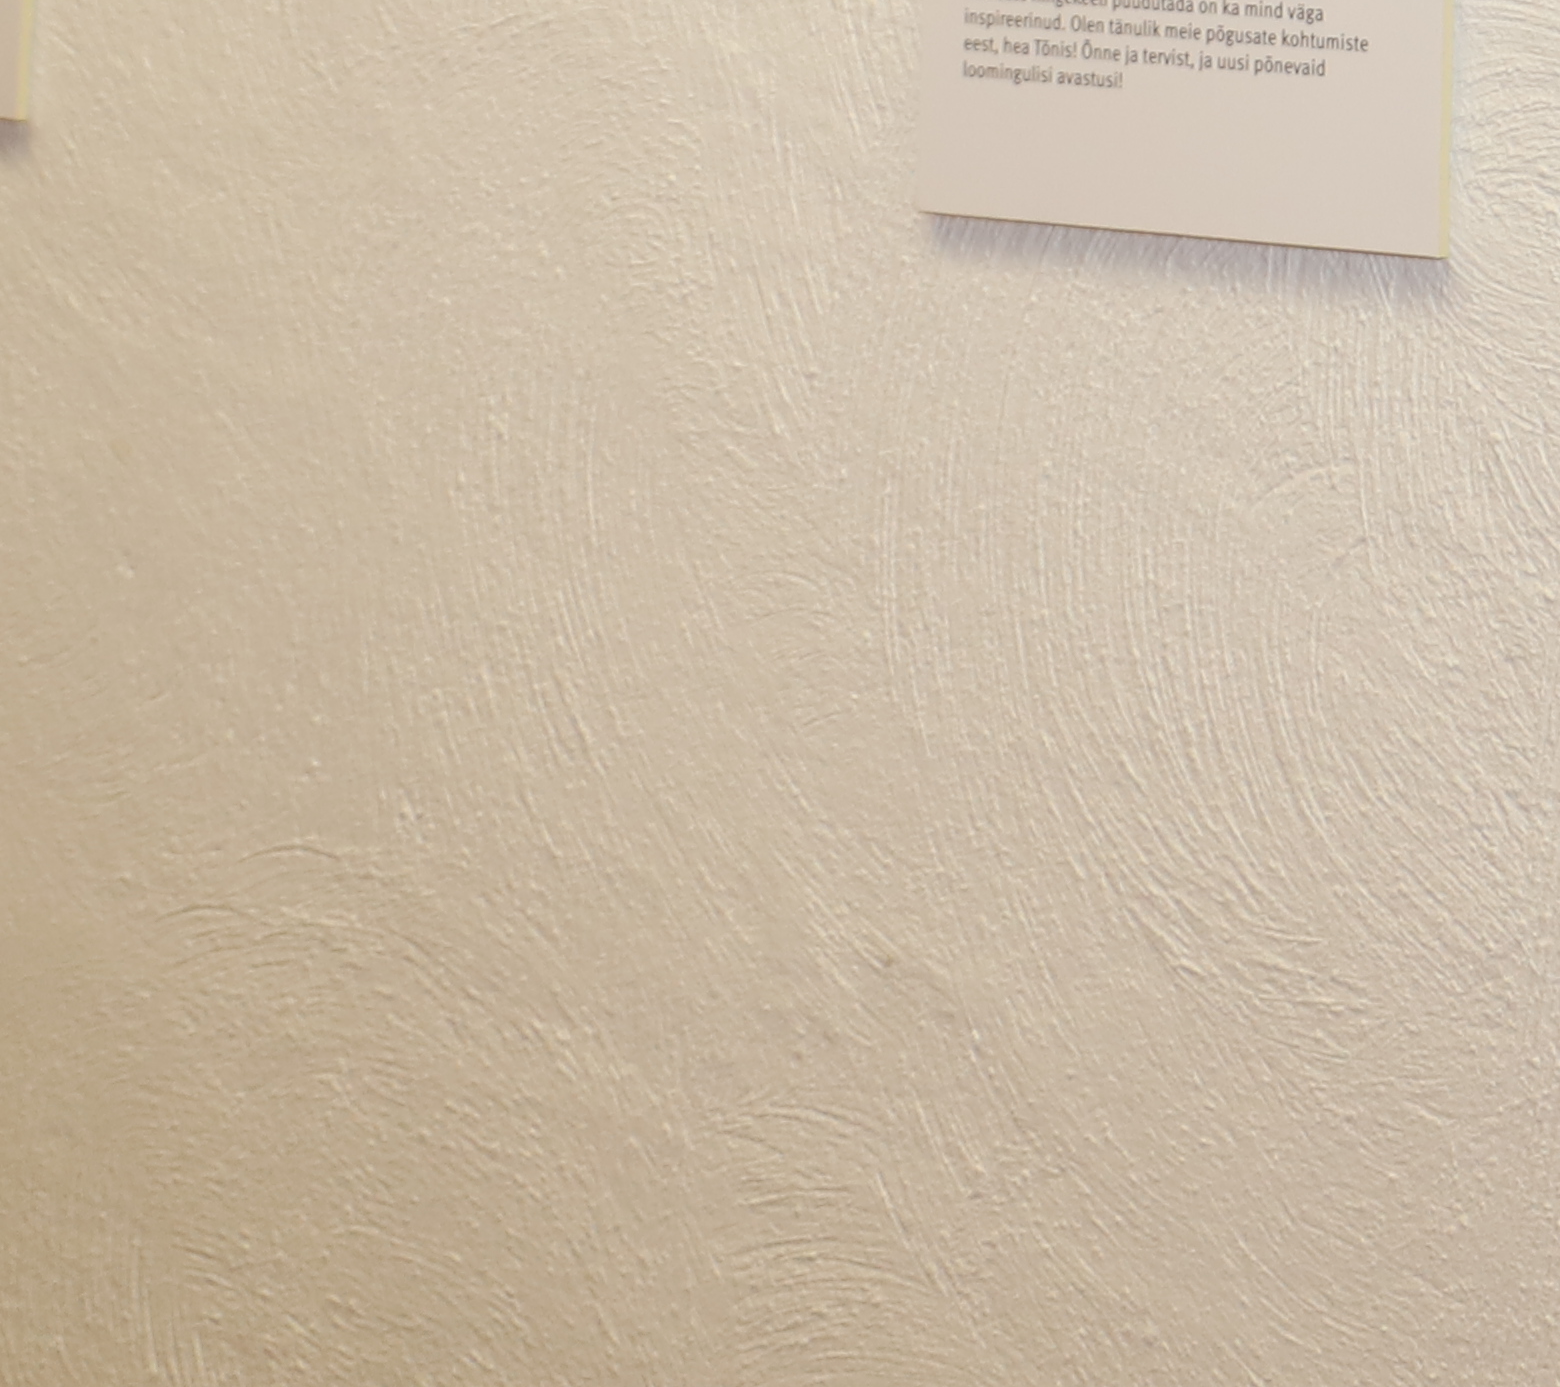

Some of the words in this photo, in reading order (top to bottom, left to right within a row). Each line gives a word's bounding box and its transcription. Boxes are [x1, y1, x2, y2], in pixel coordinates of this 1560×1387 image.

[963, 7, 1067, 32] inspireerinud.
[1069, 13, 1105, 34] Olen
[1107, 17, 1162, 38] tänulik
[1163, 21, 1203, 41] meie
[1204, 23, 1278, 48] põgusate
[1280, 27, 1370, 53] kohtumiste
[1197, 0, 1218, 15] on
[1243, 0, 1284, 20] mind
[1286, 1, 1325, 26] väga
[962, 36, 1000, 56] eest,
[1002, 35, 1031, 56] hea
[1033, 37, 1078, 59] Tõnis!
[1080, 37, 1122, 62] Õnne
[1124, 44, 1139, 66] ja
[1141, 46, 1195, 70] tervist,
[1197, 49, 1213, 72] ja
[1216, 52, 1250, 72] uusi
[1253, 54, 1326, 78] põnevaid
[962, 59, 1053, 85] loomingulisi
[1056, 70, 1124, 89] avastusi!
